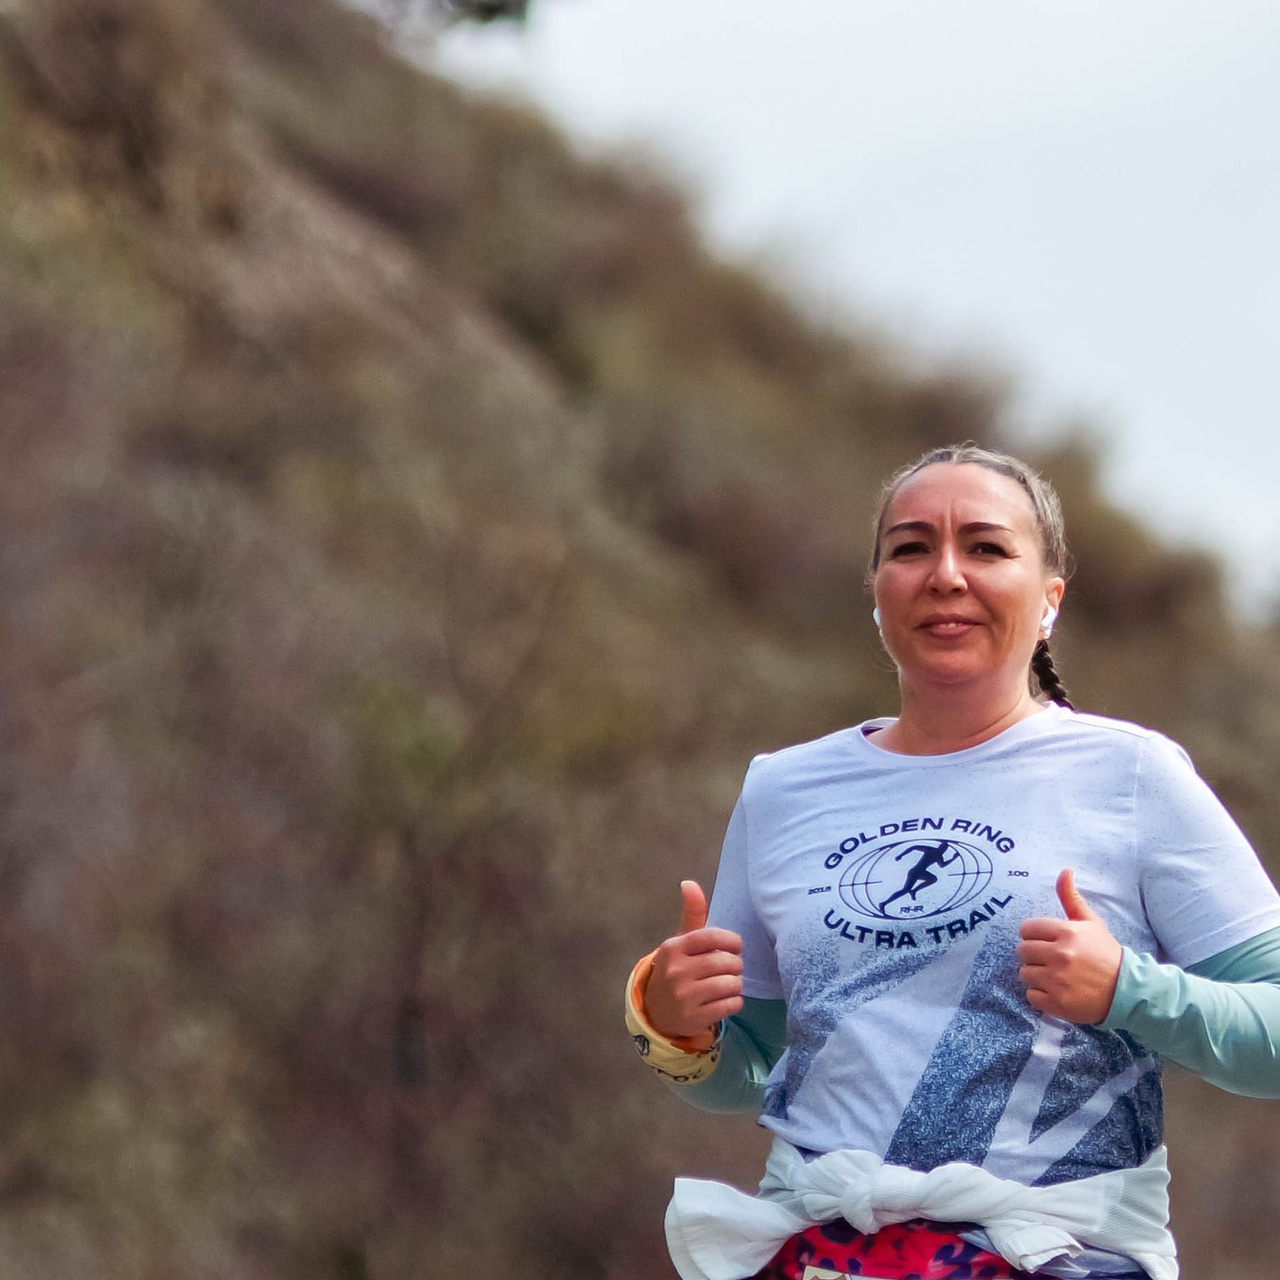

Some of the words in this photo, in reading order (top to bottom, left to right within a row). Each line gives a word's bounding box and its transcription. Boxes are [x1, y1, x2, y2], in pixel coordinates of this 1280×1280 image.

[824, 817, 944, 870] GOLDEN
[950, 819, 1015, 854] RING
[823, 909, 917, 948] ULTRA
[926, 893, 1014, 945] TRAIL
[900, 905, 924, 914] RHR
